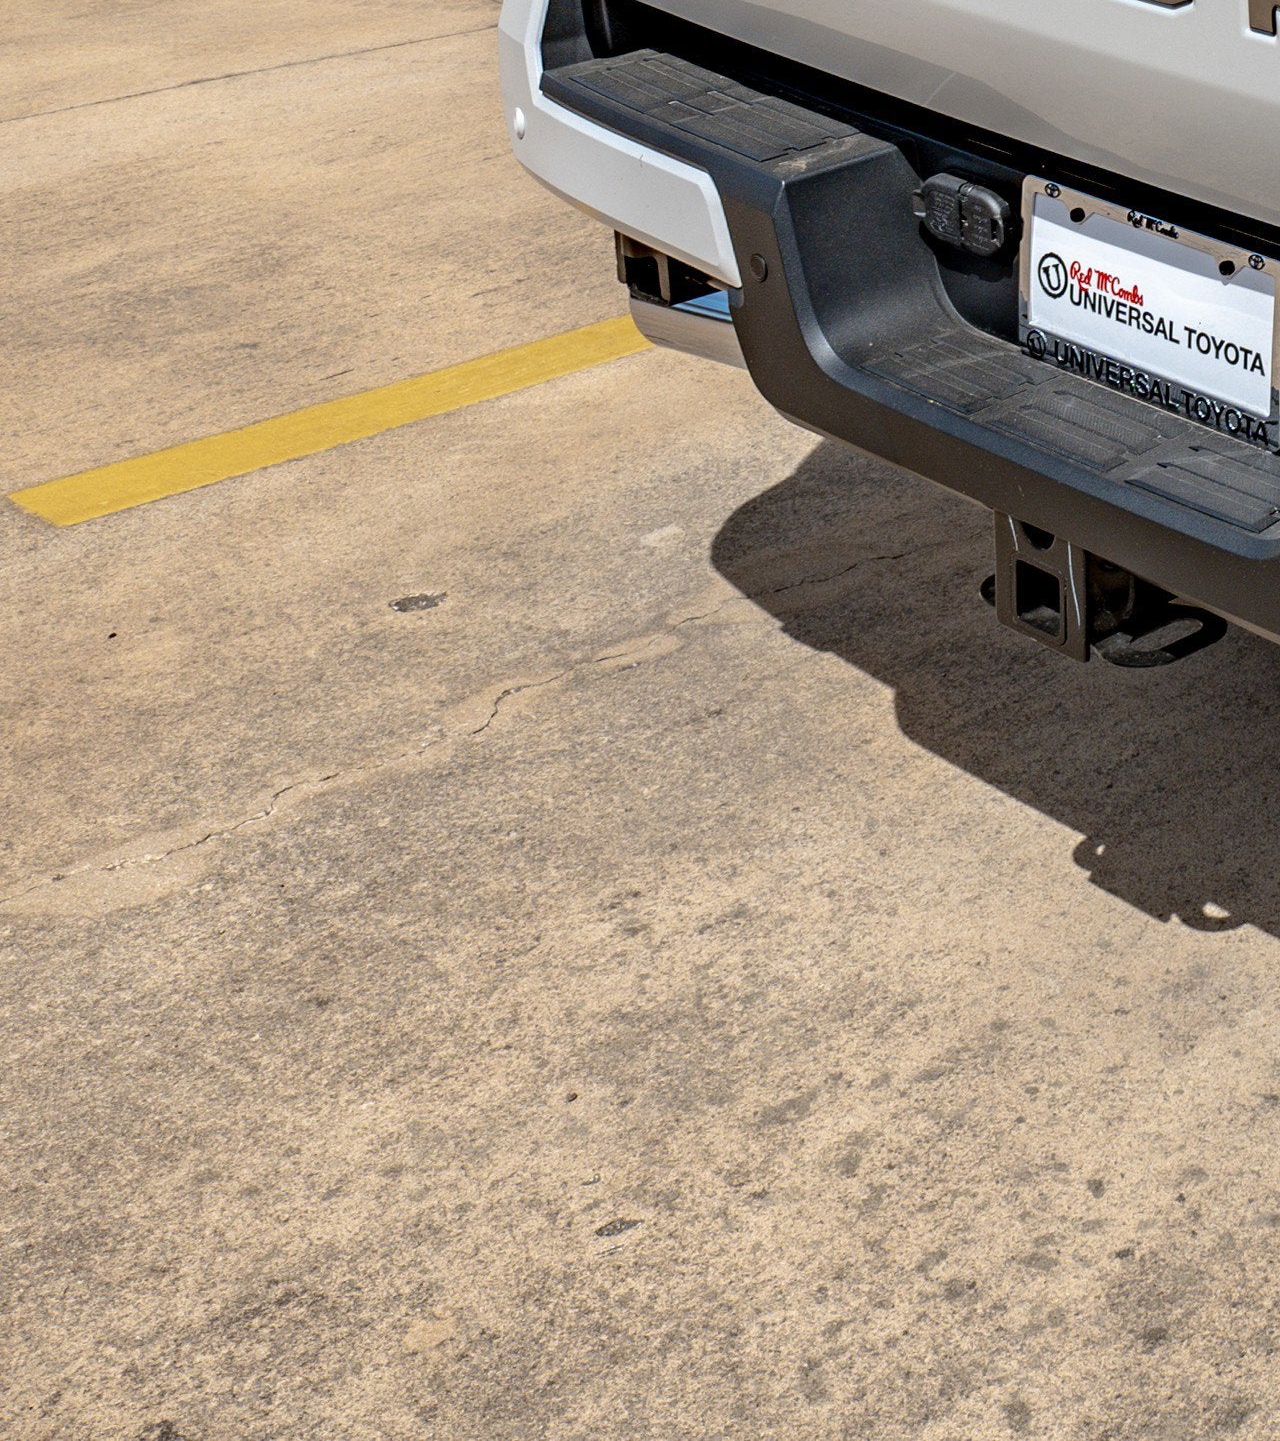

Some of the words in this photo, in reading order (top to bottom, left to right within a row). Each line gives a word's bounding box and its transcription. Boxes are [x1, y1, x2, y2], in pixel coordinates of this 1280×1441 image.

[1069, 283, 1180, 345] UNIVERSAL
[1184, 325, 1266, 377] TOYOTA
[1070, 260, 1092, 292] Red
[1095, 270, 1144, 306] McCombs
[1053, 339, 1180, 410] UNIVERSAL
[1180, 389, 1270, 446] TOYOTA
